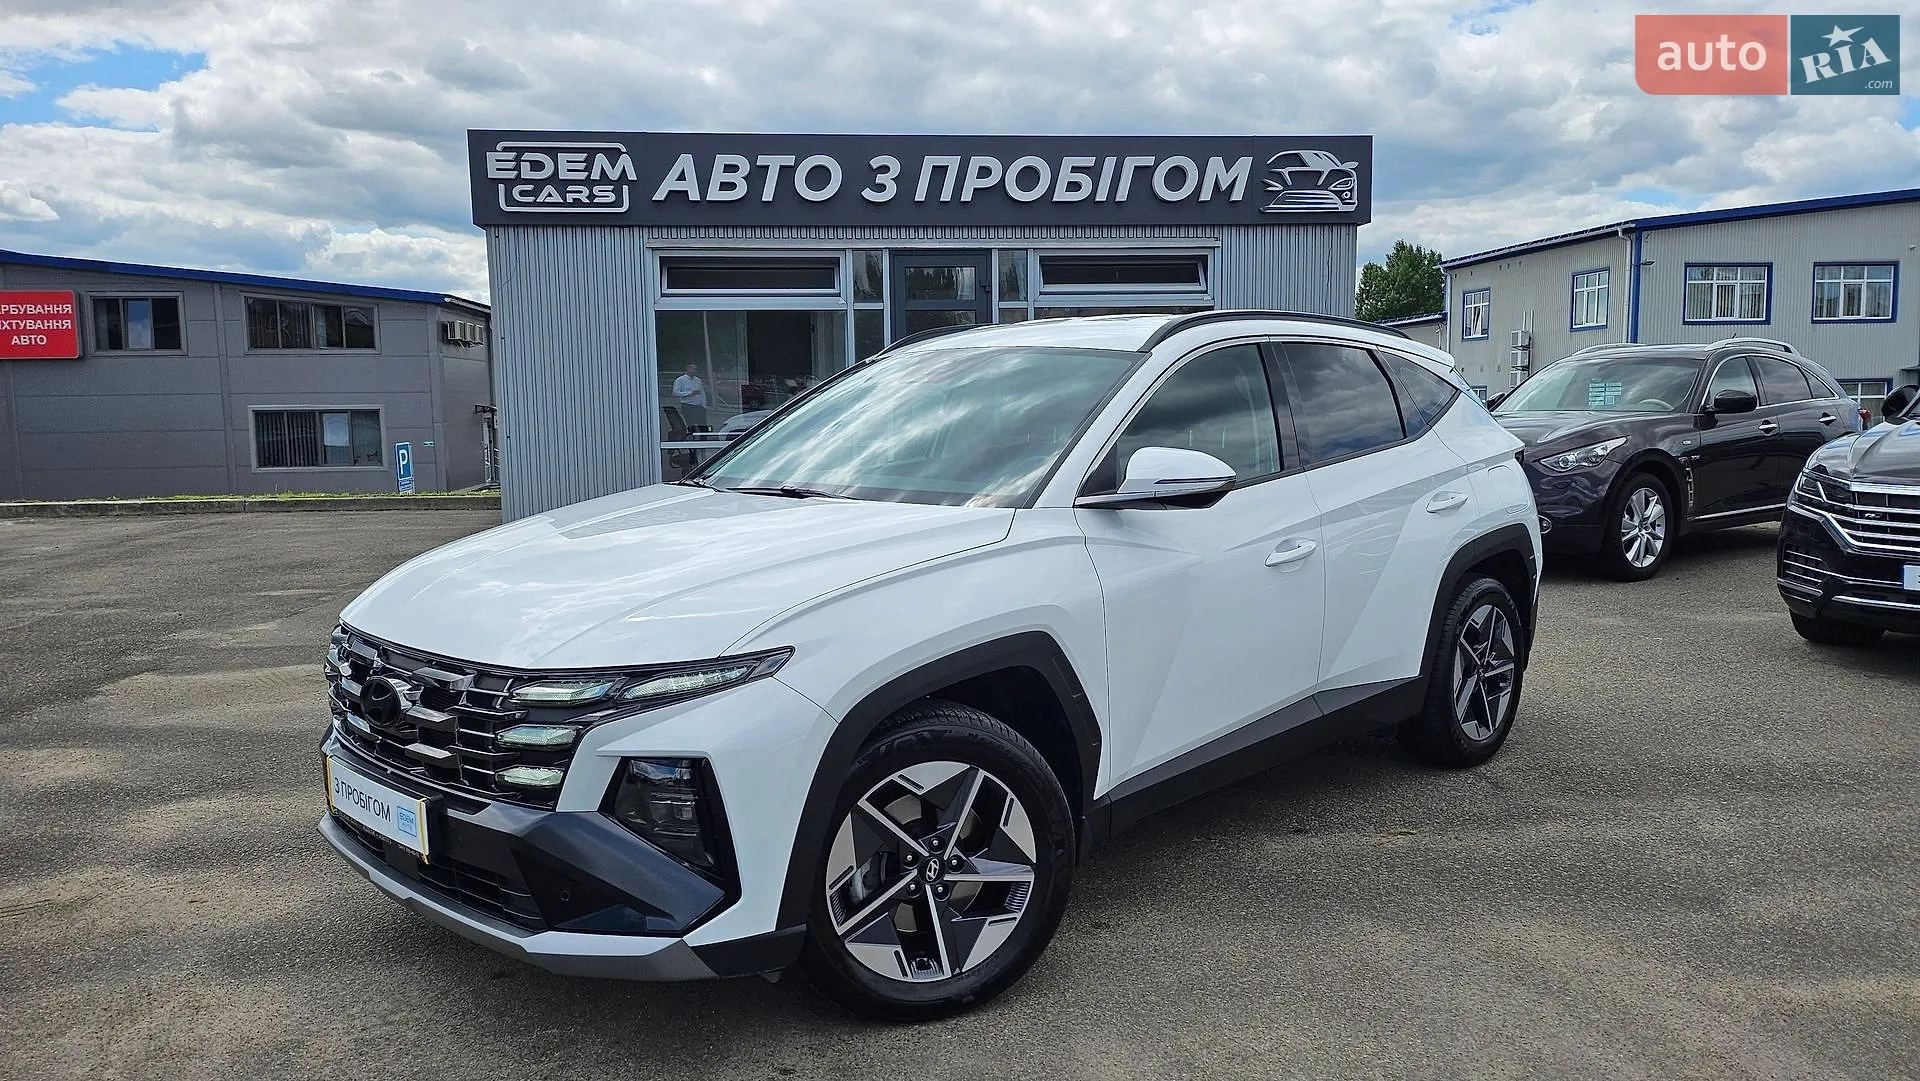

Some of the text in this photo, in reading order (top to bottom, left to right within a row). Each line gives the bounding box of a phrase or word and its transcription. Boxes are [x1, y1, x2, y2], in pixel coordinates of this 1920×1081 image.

[486, 151, 637, 181] EDEM
[652, 154, 1254, 202] АВТО З ПРОБІГОМ
[512, 184, 616, 203] CARS
[0, 304, 72, 314] РБУВАННЯ
[11, 334, 47, 345] АВТО
[399, 449, 408, 475] P
[341, 781, 391, 822] ПРОБІГОМ
